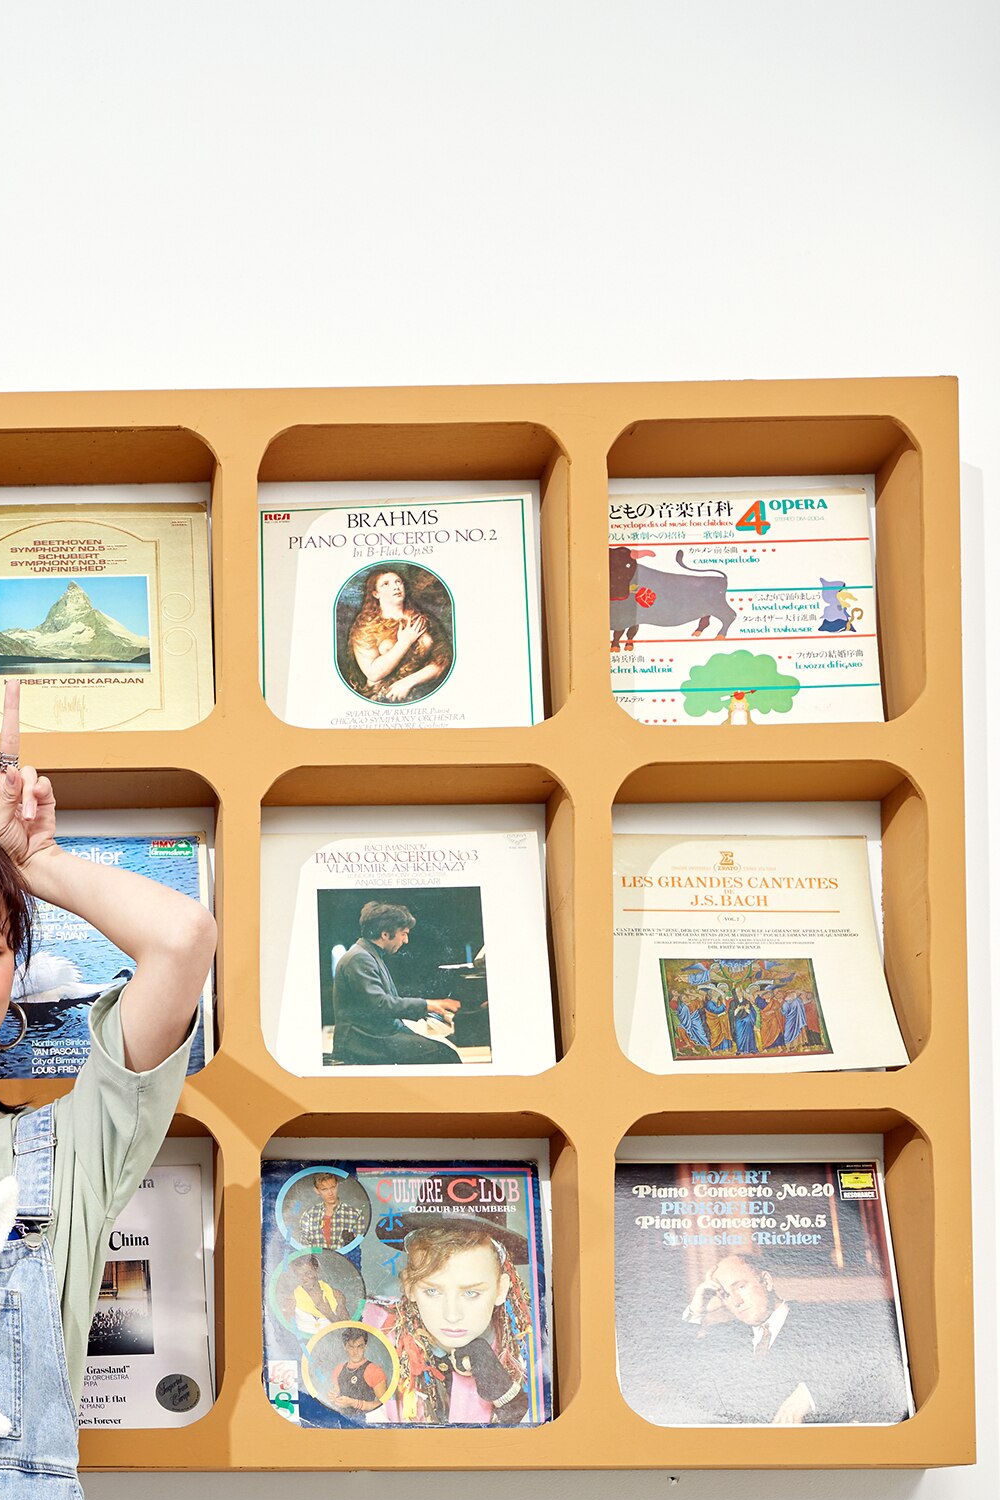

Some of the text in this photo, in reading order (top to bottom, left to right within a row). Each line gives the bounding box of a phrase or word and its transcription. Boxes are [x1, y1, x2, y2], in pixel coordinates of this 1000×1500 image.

[264, 513, 291, 521] RCA
[346, 509, 439, 529] BRAHMS
[734, 499, 772, 536] 4
[289, 533, 347, 550] PIANO
[353, 530, 450, 548] CONCERTO
[353, 547, 363, 558] In
[4, 678, 58, 686] HRBERT
[152, 840, 175, 848] HMV
[315, 852, 360, 864] PIANO
[364, 850, 446, 863] CONCERTO
[326, 861, 467, 873] VLADIMIR ASHKENAZY
[355, 877, 441, 887] ANATOLE FISTOULARI
[621, 875, 839, 890] LES GRANDES CANTATES
[721, 895, 769, 907] BACH
[56, 931, 88, 940] SWAN
[31, 1039, 64, 1047] Northern
[31, 1047, 80, 1056] YAN PASCAL
[31, 1057, 55, 1066] City of
[31, 1066, 56, 1074] LOUIS
[690, 1170, 772, 1185] MOZART
[375, 1177, 521, 1204] CULTURE CLUB
[631, 1184, 689, 1199] Piano
[693, 1183, 773, 1198] Concerto
[468, 1205, 517, 1213] NUMBERS
[660, 1200, 776, 1216] PROKOFIEV
[635, 1215, 693, 1230] Piano
[696, 1214, 777, 1229] Concerto
[108, 1230, 150, 1251] China
[378, 1206, 404, 1277] ボーイ
[750, 1231, 822, 1246] Richter
[112, 1395, 127, 1403] flat
[93, 1417, 122, 1425] Forever
